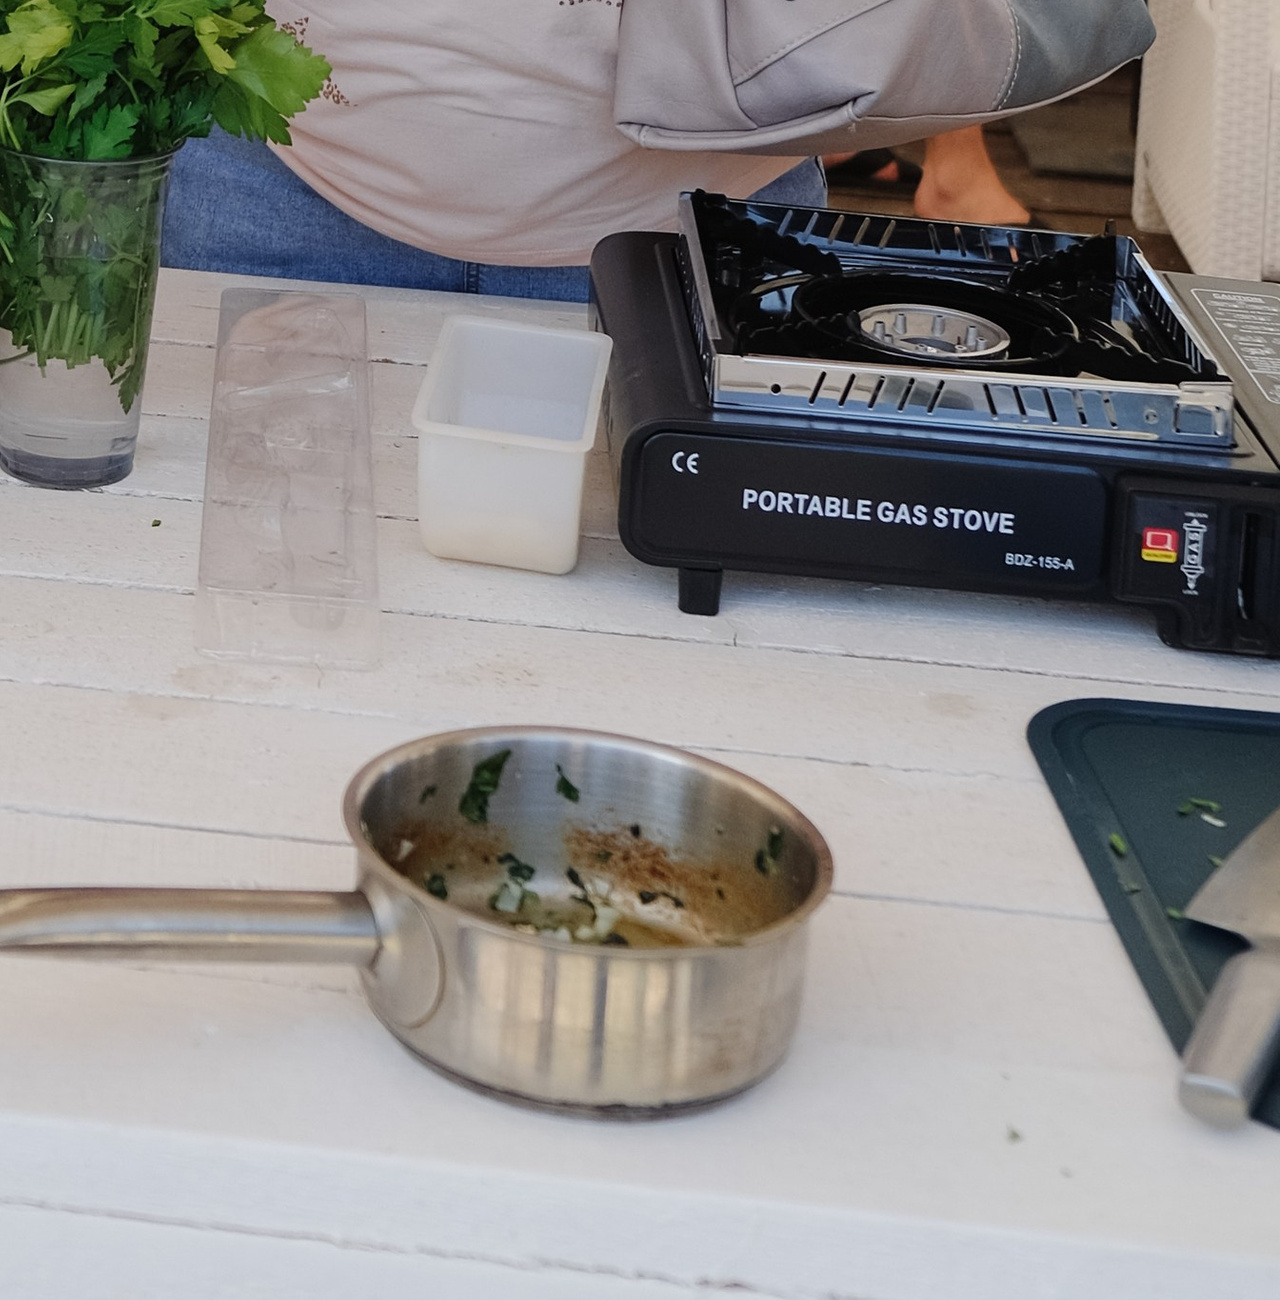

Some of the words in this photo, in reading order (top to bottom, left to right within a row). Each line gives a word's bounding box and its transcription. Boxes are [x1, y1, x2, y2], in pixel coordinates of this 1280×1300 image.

[671, 451, 700, 474] CE
[742, 488, 872, 521] PORTABLE
[877, 501, 928, 526] GAS
[932, 506, 1015, 535] STOVE
[1186, 532, 1200, 564] GAS
[1005, 553, 1075, 571] BDZ-155-A
